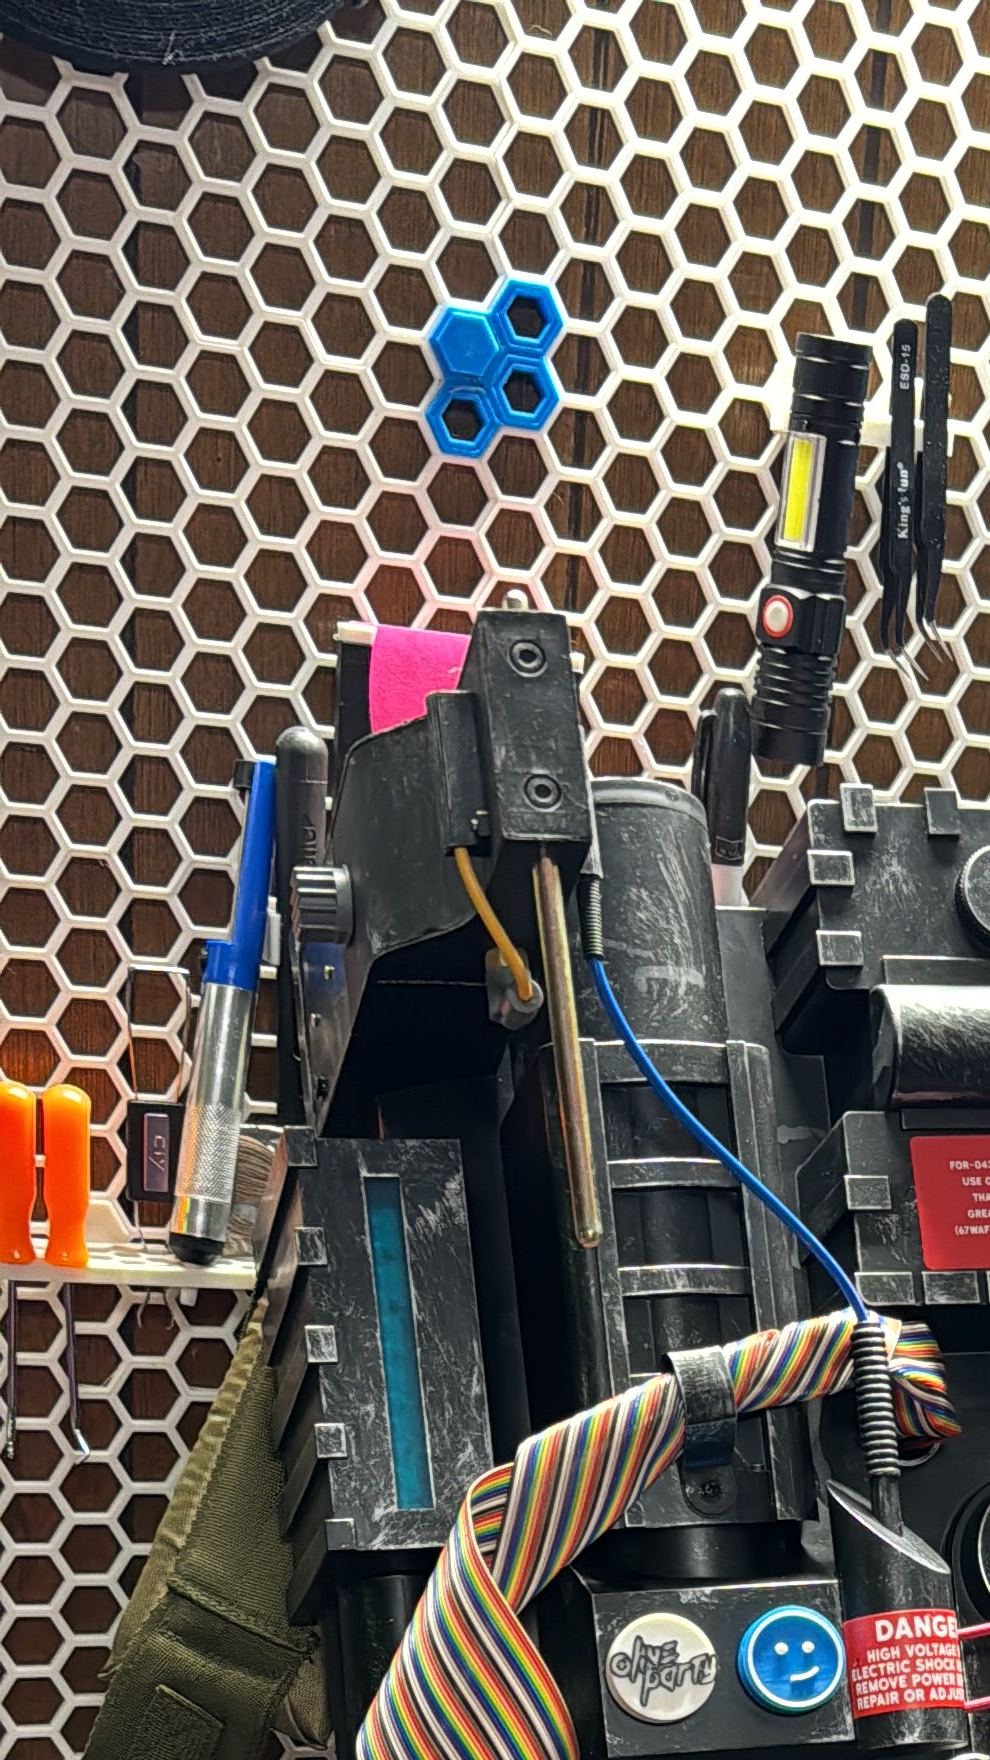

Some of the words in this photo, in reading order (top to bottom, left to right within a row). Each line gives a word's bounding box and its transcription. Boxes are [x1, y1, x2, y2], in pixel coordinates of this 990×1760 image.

[962, 1176, 982, 1186] USE
[875, 1614, 958, 1642] DANGE
[866, 1645, 901, 1663] HIGH
[904, 1642, 957, 1658] VOLTAGE
[851, 1659, 911, 1682] ELECTRIC
[915, 1658, 956, 1672] SHOCK
[856, 1674, 908, 1697] REMOVE
[911, 1672, 956, 1687] POWER
[857, 1691, 900, 1711] REPAIR
[904, 1688, 926, 1703] OR
